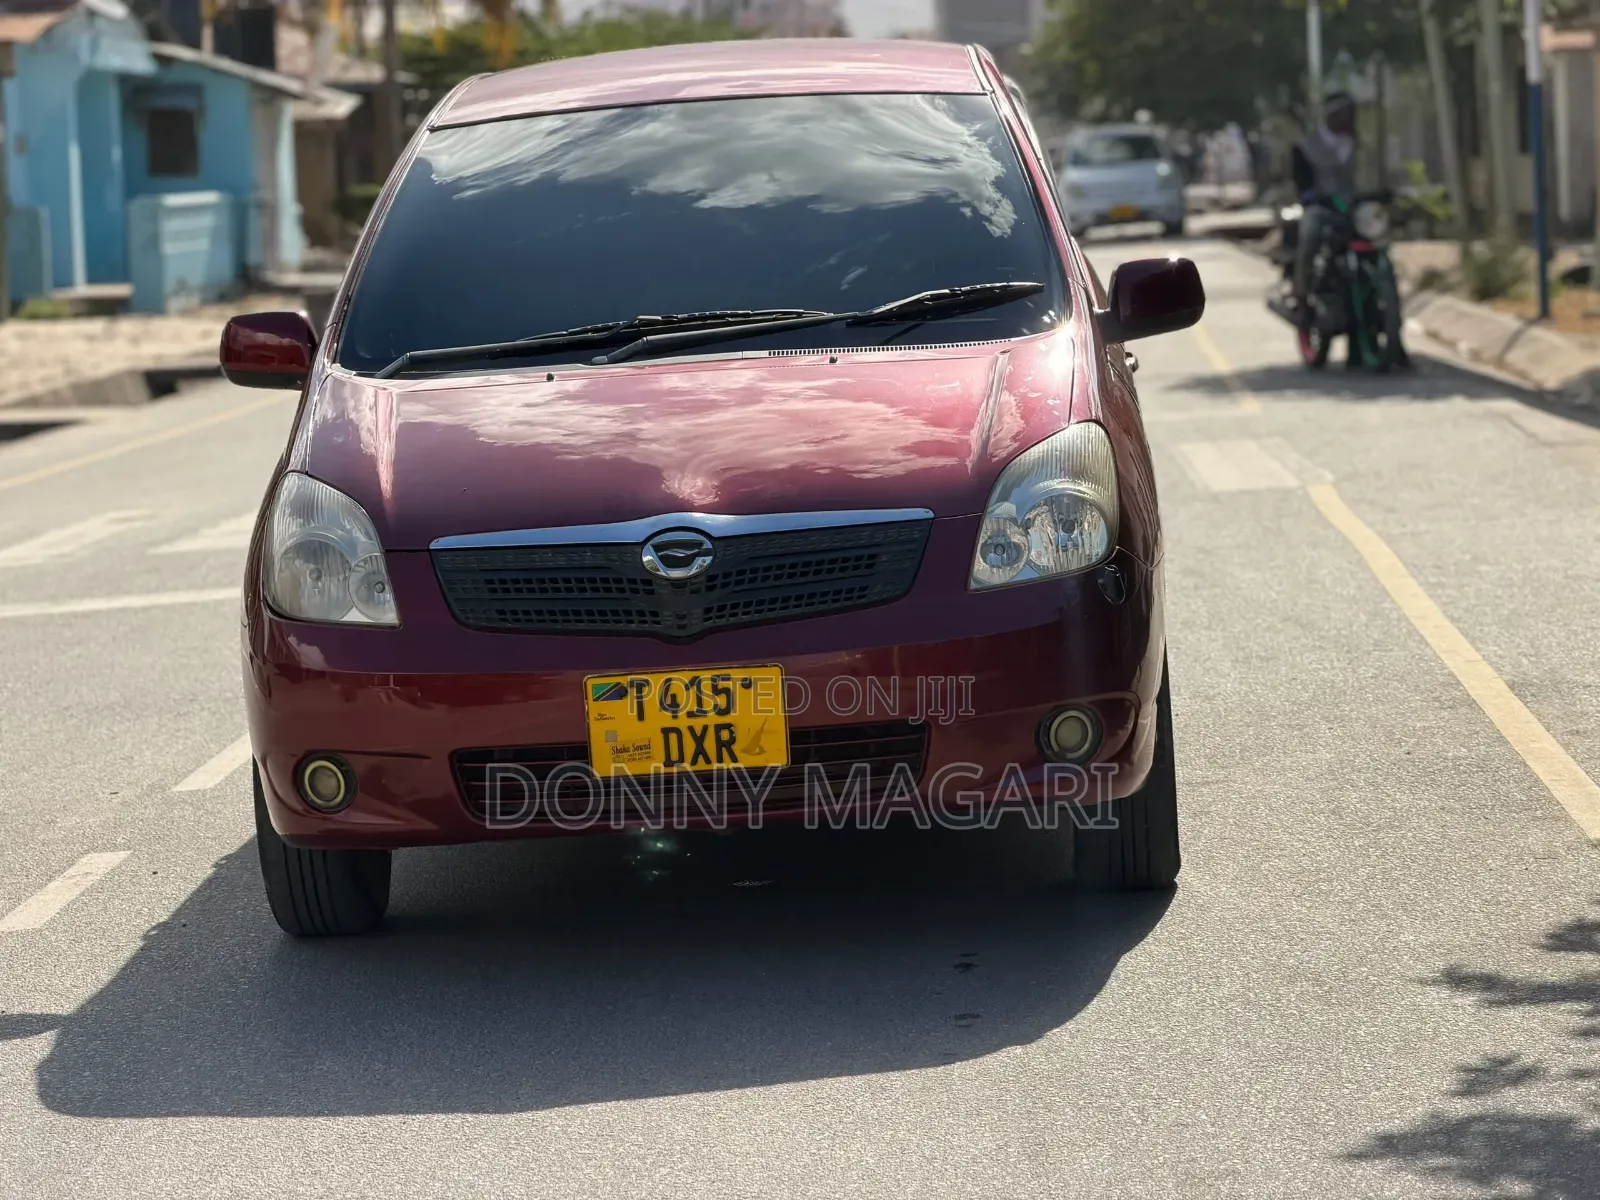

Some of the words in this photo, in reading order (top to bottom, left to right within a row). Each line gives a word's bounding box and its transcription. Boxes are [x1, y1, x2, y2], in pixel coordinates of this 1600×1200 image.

[625, 679, 650, 722] T
[659, 673, 735, 719] 415
[660, 722, 739, 768] DXR
